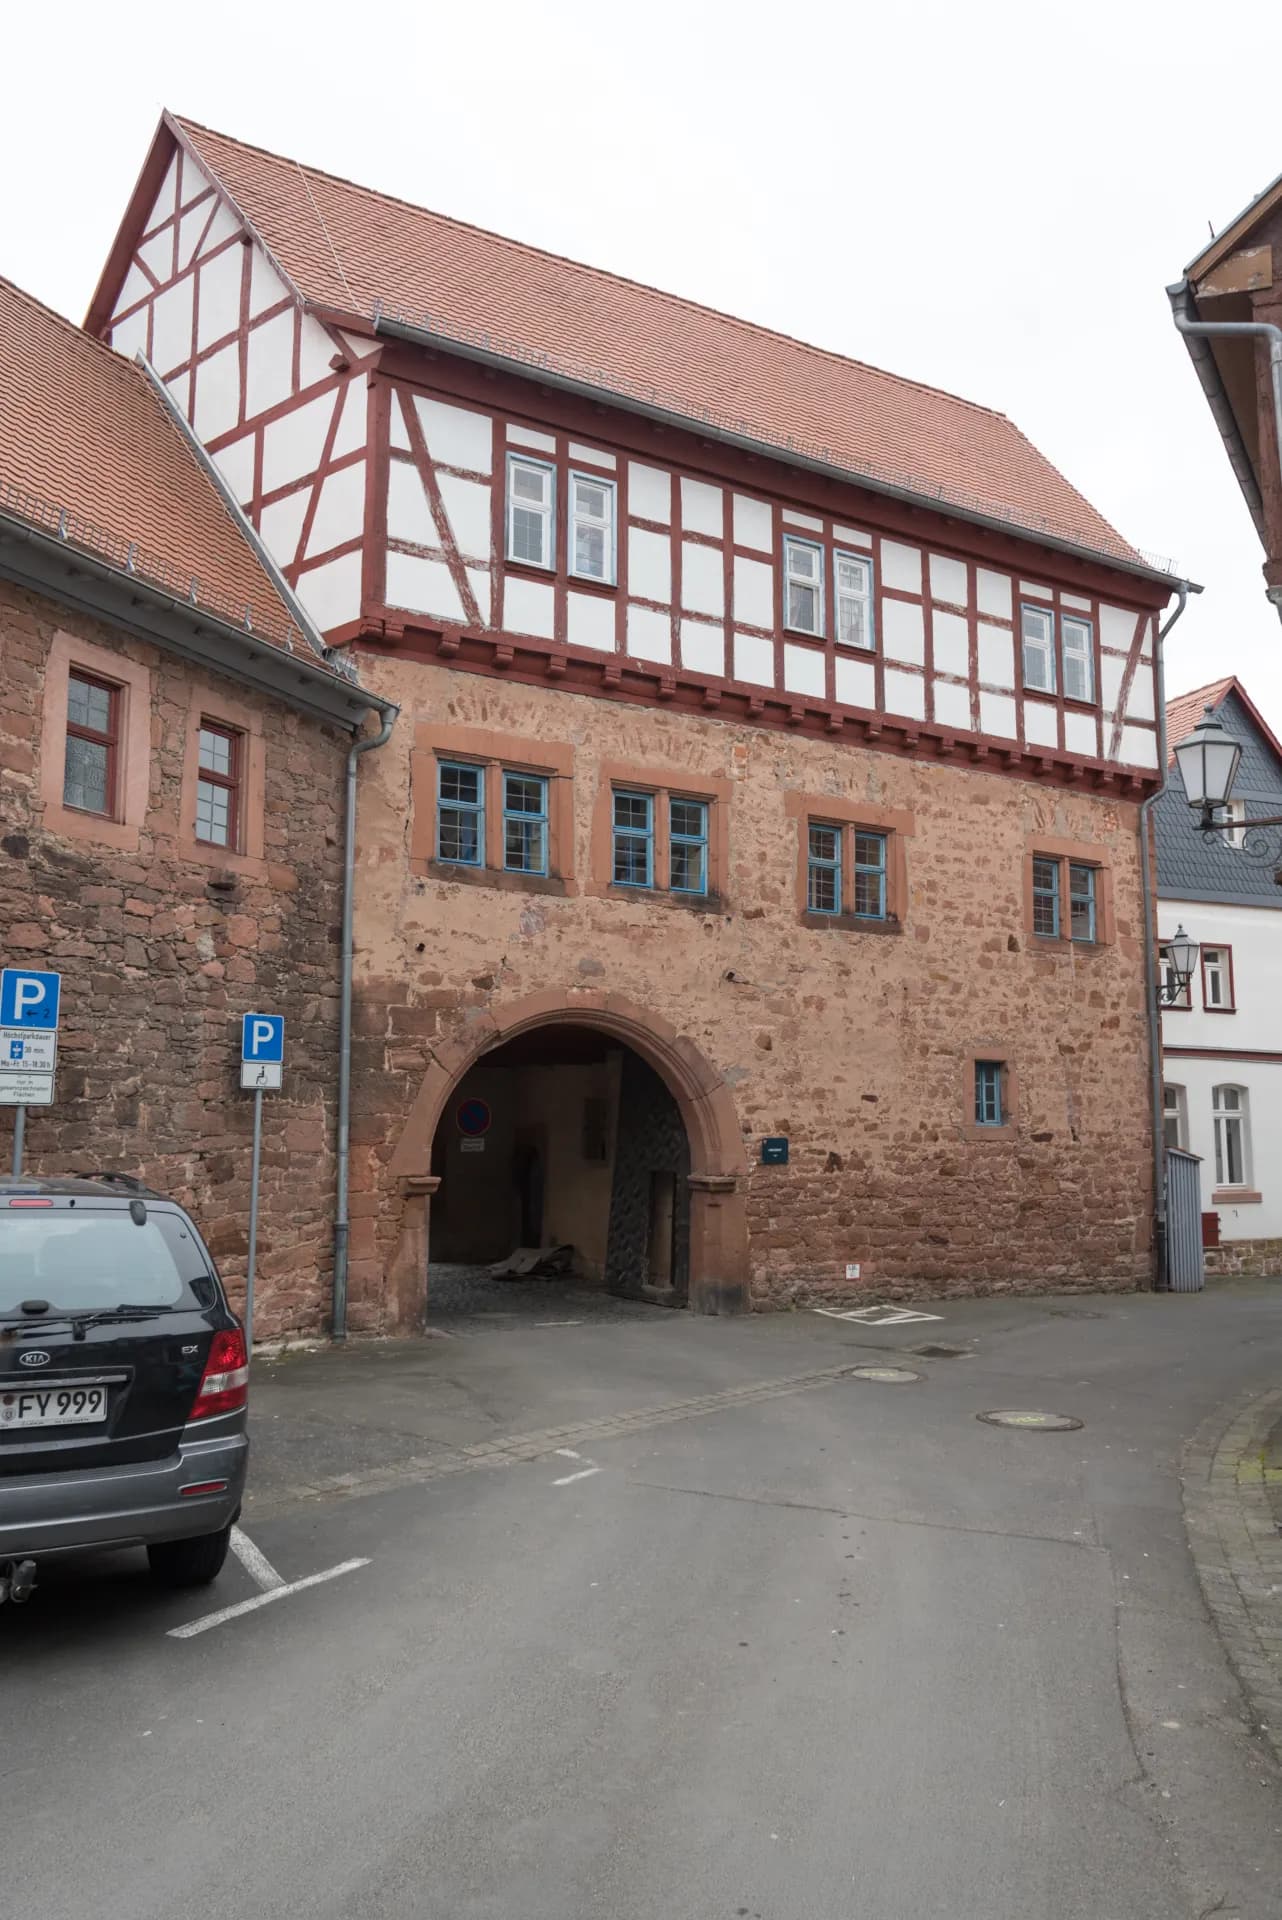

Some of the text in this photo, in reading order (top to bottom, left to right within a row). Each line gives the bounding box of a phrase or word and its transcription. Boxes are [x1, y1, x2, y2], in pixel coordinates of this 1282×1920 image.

[13, 977, 46, 1020] P
[252, 1020, 274, 1055] P
[25, 1354, 45, 1363] KIA
[181, 1345, 199, 1354] EX
[18, 1390, 102, 1418] FY 999
